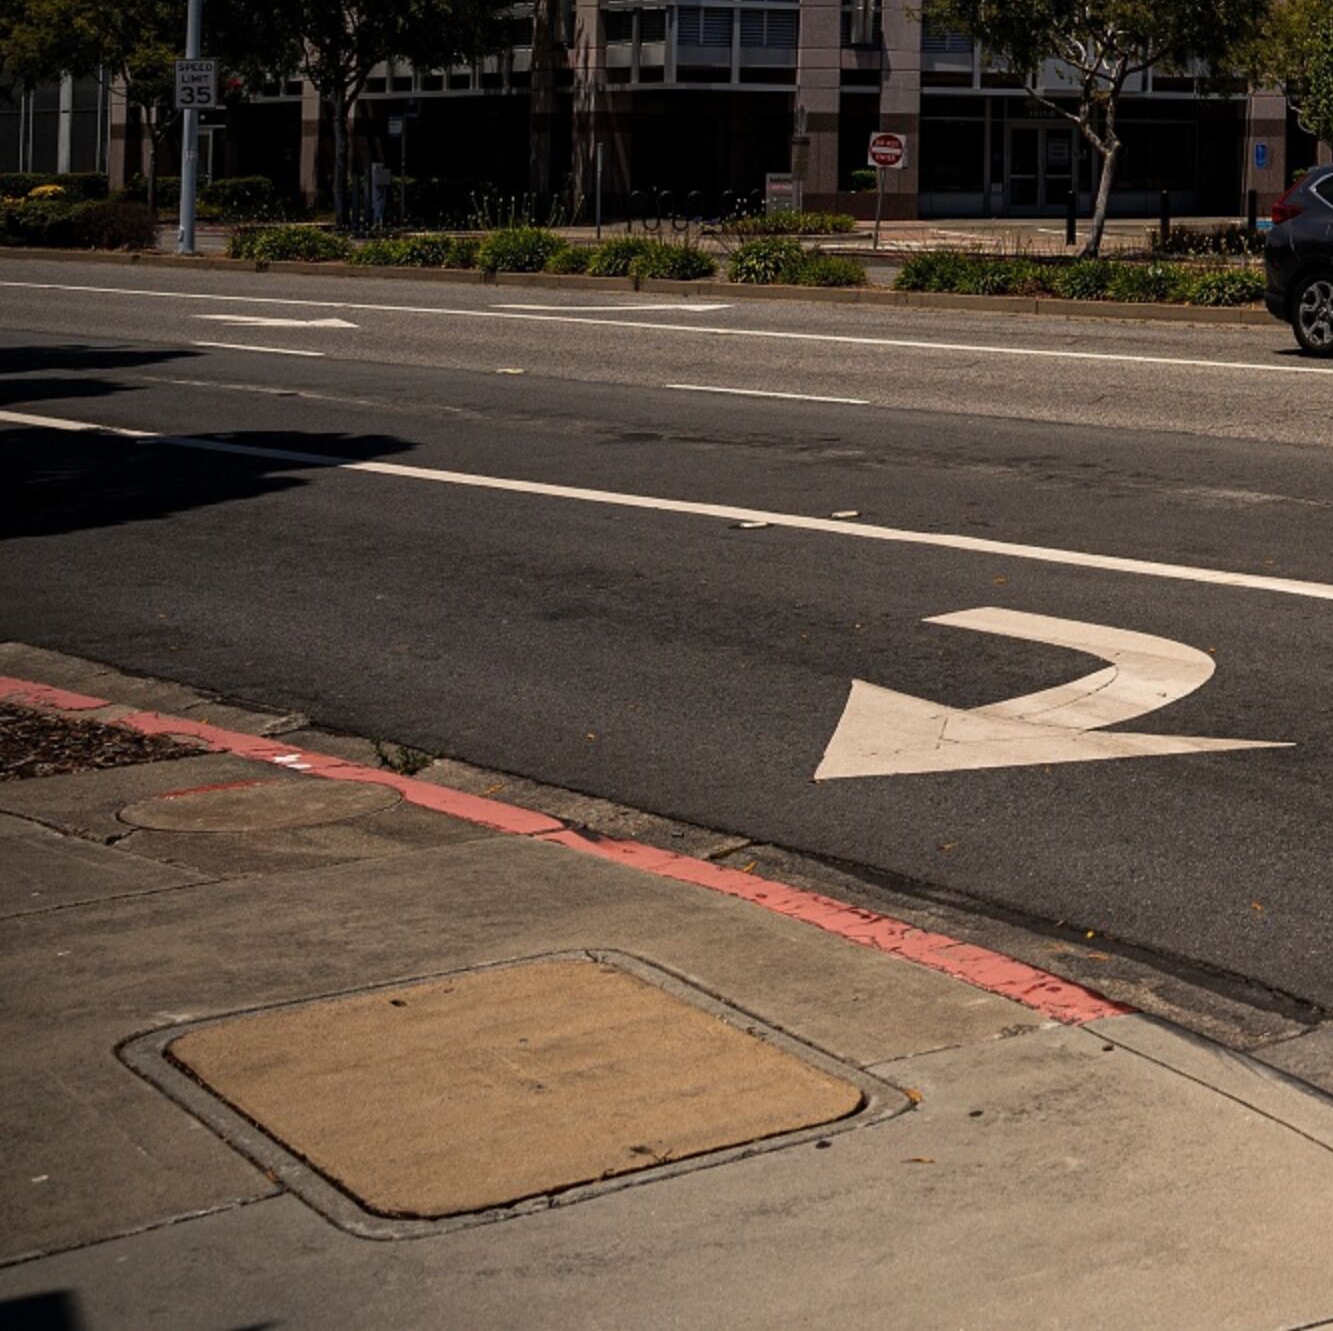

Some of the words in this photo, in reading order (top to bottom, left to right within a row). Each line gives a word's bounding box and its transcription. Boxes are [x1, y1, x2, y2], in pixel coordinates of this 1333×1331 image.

[178, 62, 212, 71] SPEED
[181, 74, 208, 84] LIMIT
[181, 87, 211, 104] 35
